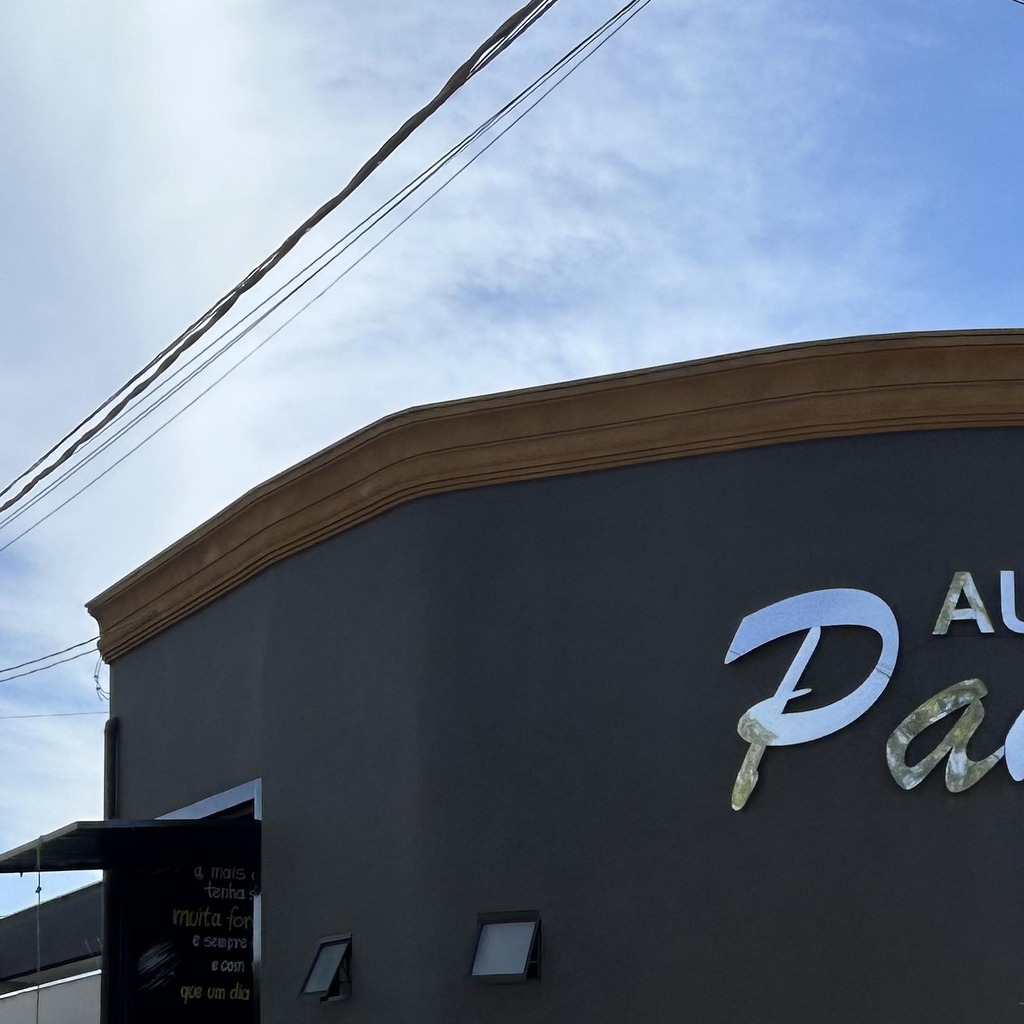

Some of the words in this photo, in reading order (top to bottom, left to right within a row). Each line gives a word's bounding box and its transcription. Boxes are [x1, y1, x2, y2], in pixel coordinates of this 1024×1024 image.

[211, 865, 247, 880] mais
[204, 881, 246, 900] tenha
[172, 906, 222, 927] muita
[192, 934, 200, 947] e
[204, 936, 248, 950] sempre
[220, 960, 245, 972] com
[180, 985, 203, 1005] que
[207, 986, 226, 1000] um
[229, 981, 250, 1001] dia
